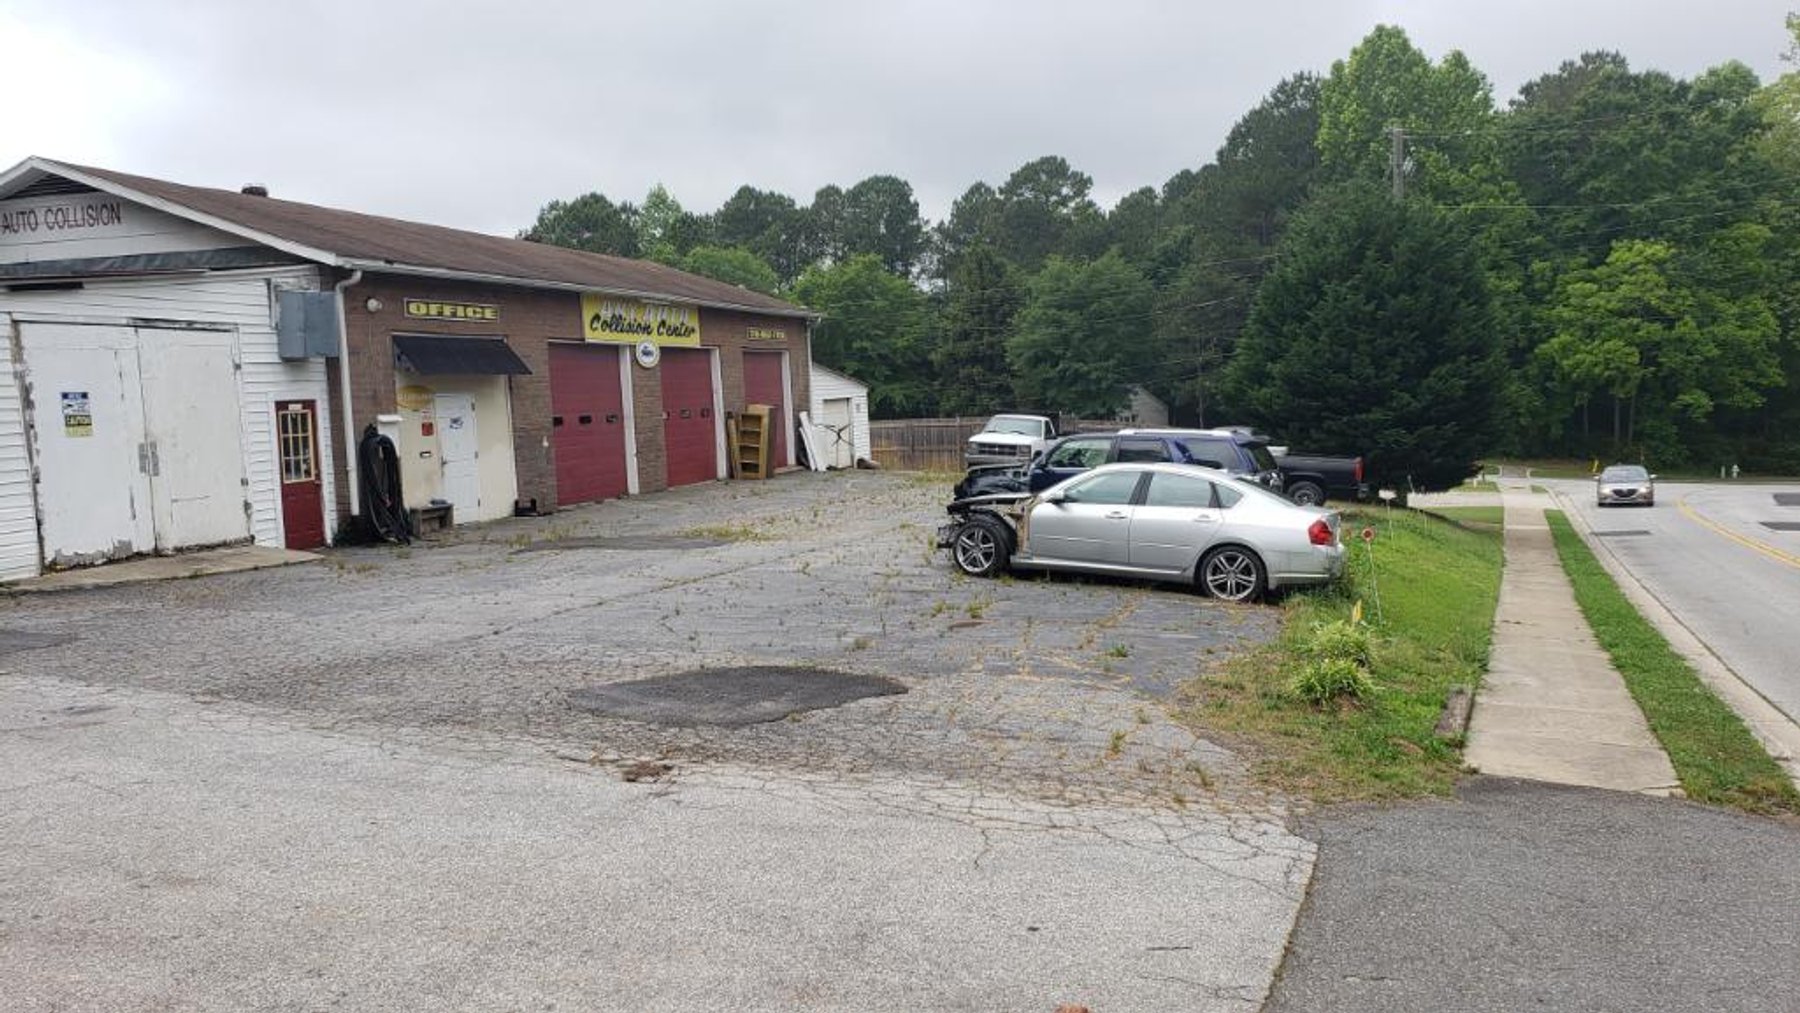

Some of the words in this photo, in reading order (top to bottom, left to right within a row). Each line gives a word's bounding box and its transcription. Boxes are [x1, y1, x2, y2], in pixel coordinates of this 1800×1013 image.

[1, 208, 39, 235] AUTO
[44, 202, 122, 231] COLLISION
[408, 301, 498, 319] OFFICE
[590, 312, 654, 336] Collision
[656, 319, 696, 338] Center
